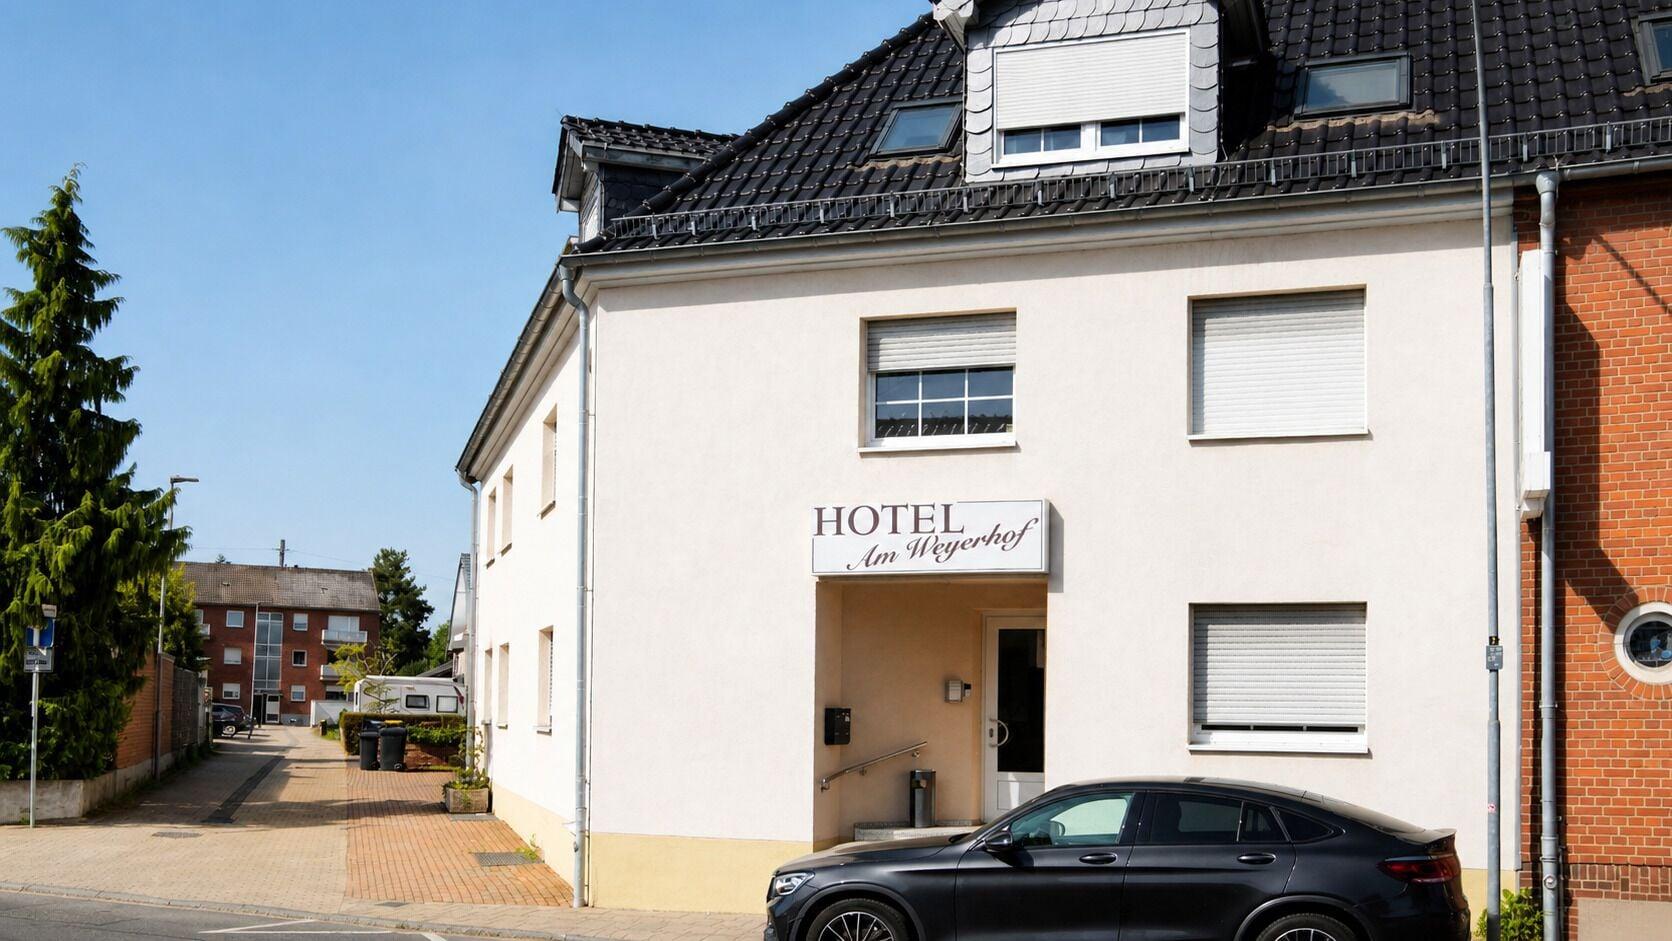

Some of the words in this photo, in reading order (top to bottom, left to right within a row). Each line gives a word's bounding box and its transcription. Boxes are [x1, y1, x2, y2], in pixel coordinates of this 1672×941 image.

[813, 502, 965, 536] HOTEL
[846, 544, 900, 570] Am
[906, 517, 1039, 563] Weyerhof
